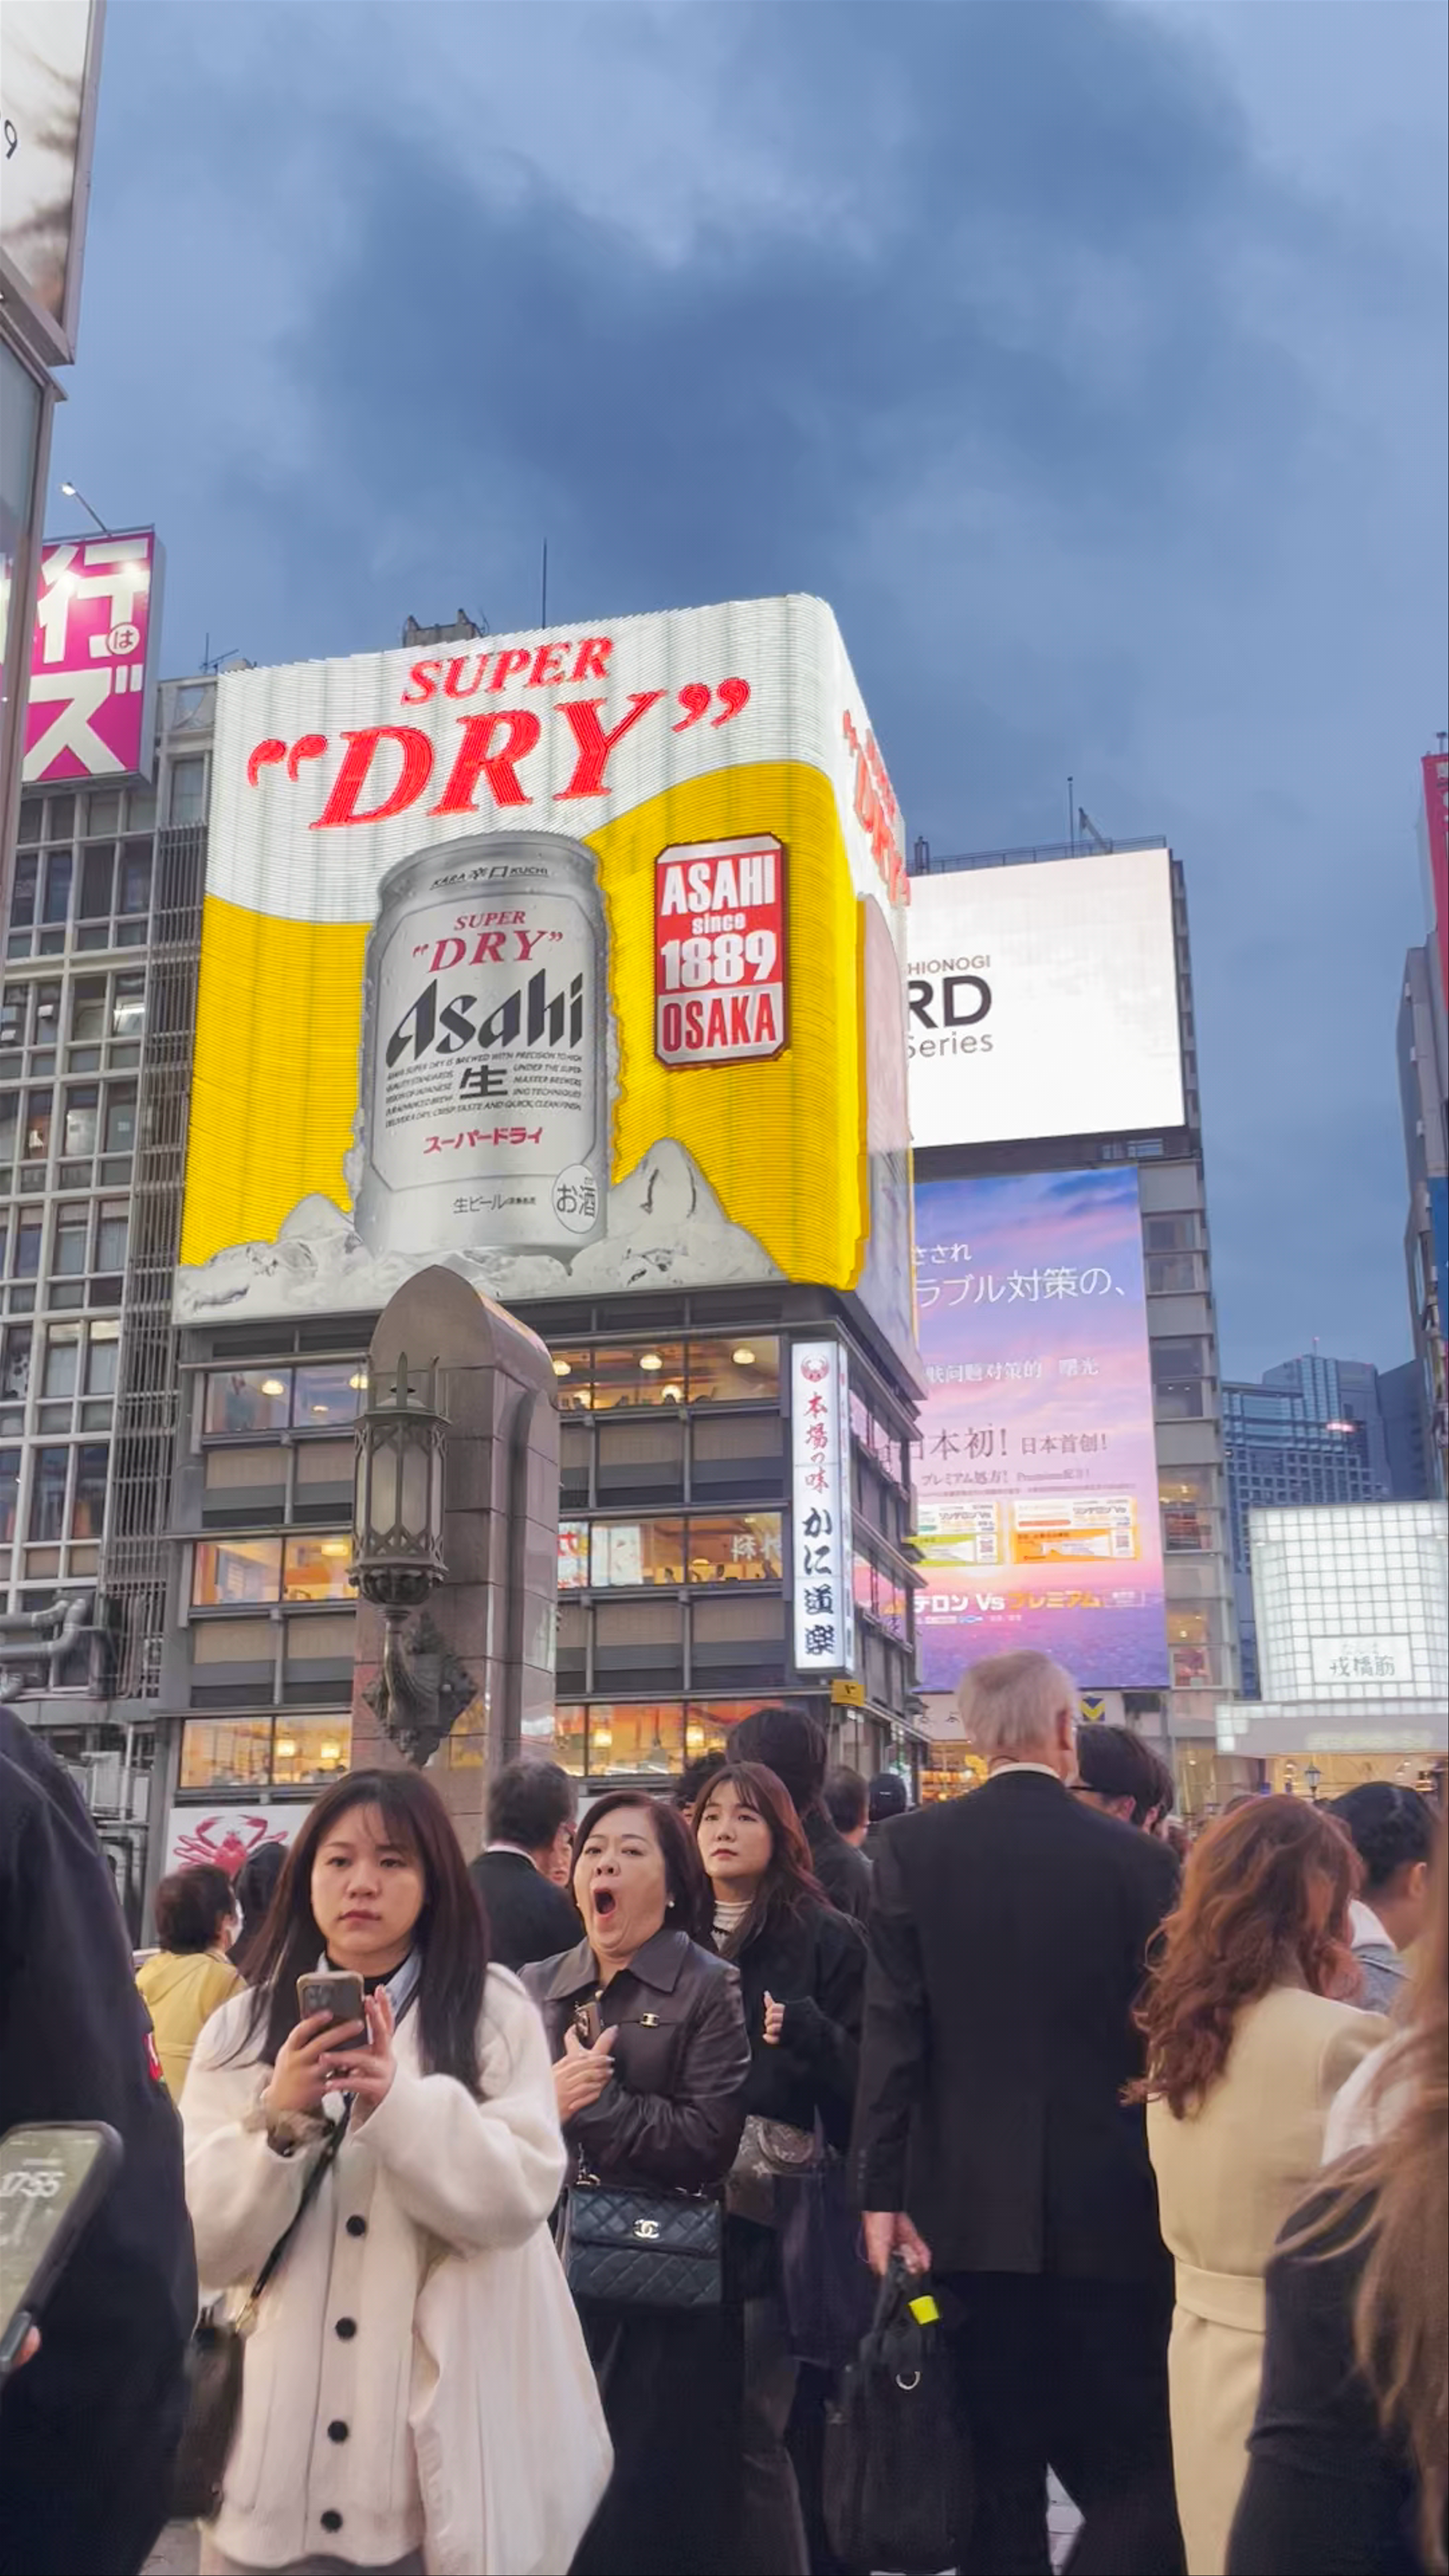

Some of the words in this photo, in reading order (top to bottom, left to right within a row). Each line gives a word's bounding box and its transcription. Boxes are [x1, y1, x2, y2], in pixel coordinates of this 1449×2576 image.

[401, 637, 615, 706] SUPER
[510, 866, 548, 877] KUCHI
[661, 855, 775, 916] ASAHI
[454, 910, 526, 930] SUPER
[692, 912, 746, 935] since
[661, 930, 777, 990] 1889
[385, 968, 583, 1068] Asahi
[663, 993, 777, 1052] OSAKA
[459, 1065, 508, 1099] 生
[423, 1127, 543, 1154] スーパードライ
[804, 1391, 829, 1494] 本場の味
[802, 1507, 835, 1656] かに道楽
[977, 1592, 1005, 1610] Vs
